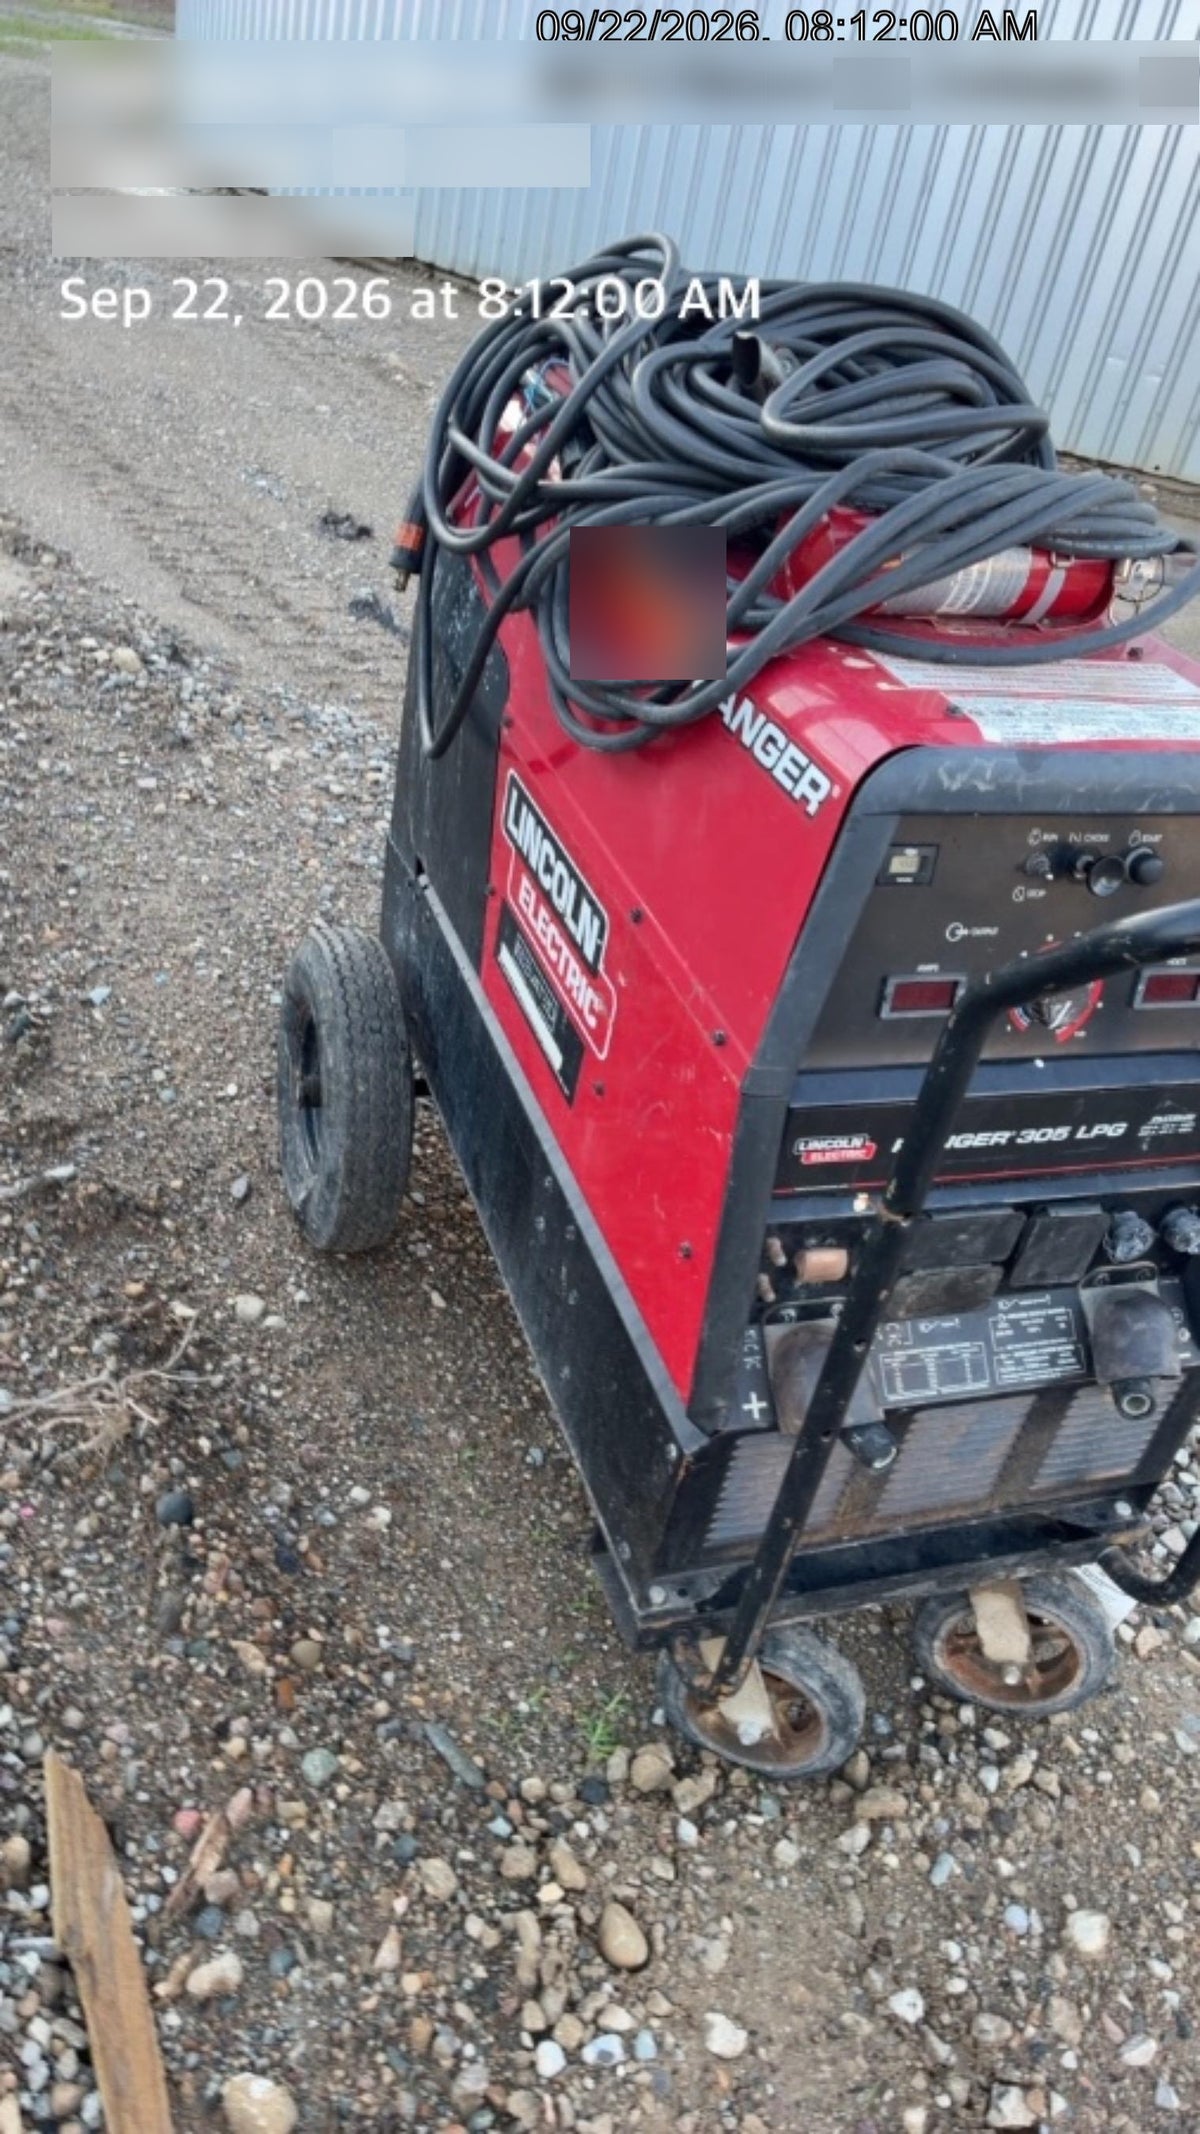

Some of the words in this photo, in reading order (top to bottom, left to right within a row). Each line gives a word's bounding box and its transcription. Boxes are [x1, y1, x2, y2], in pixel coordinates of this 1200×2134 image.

[718, 691, 832, 817] ANGER
[506, 786, 600, 965] LINCOLN
[518, 873, 603, 1029] ELECTRIC
[798, 1136, 864, 1150] LINCOLN
[811, 1149, 867, 1161] ELECTRIC
[1015, 1126, 1072, 1144] 305
[1075, 1122, 1129, 1139] LPG
